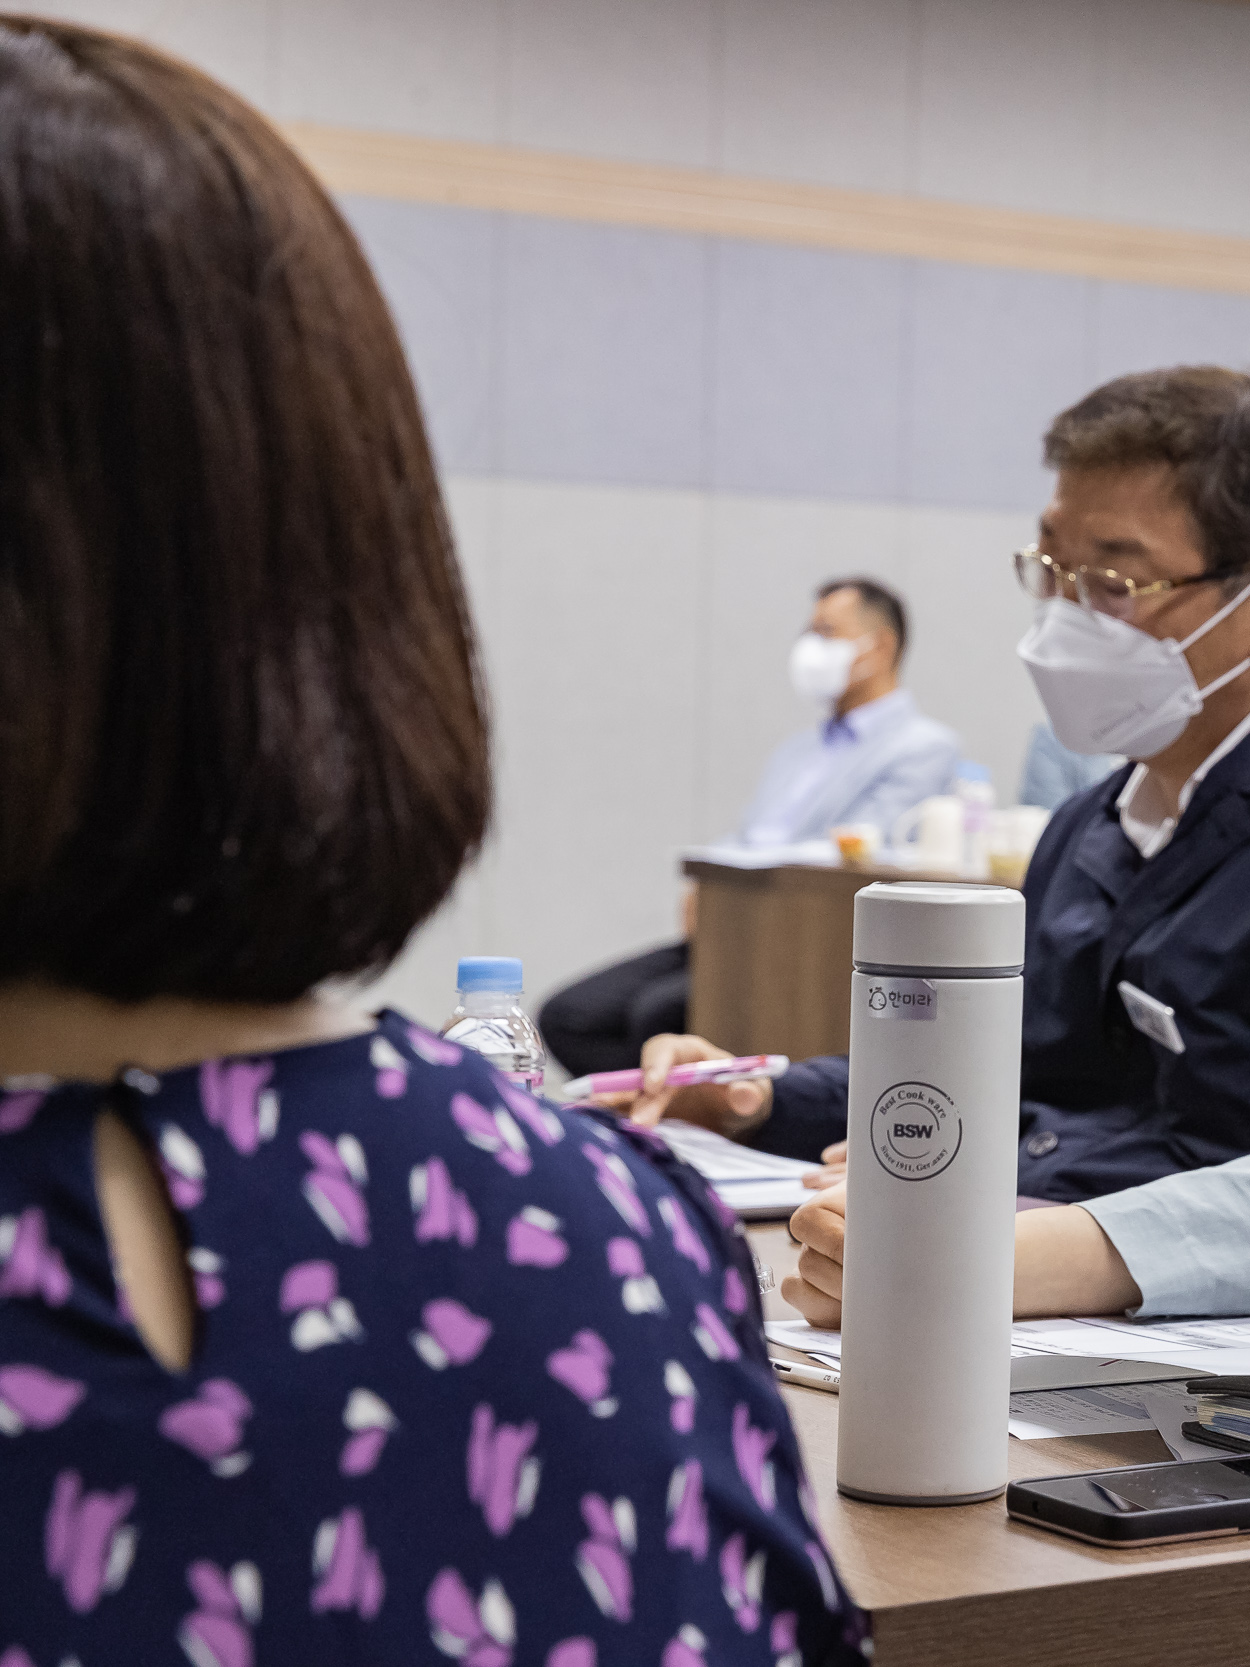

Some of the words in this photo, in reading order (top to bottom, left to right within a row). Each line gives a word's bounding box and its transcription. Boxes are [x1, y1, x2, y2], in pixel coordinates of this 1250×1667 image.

[889, 991, 932, 1009] 한미라
[879, 1096, 897, 1116] Best
[897, 1089, 925, 1101] Cook
[927, 1097, 947, 1119] ware
[893, 1123, 934, 1139] BSW
[880, 1144, 895, 1164] Since
